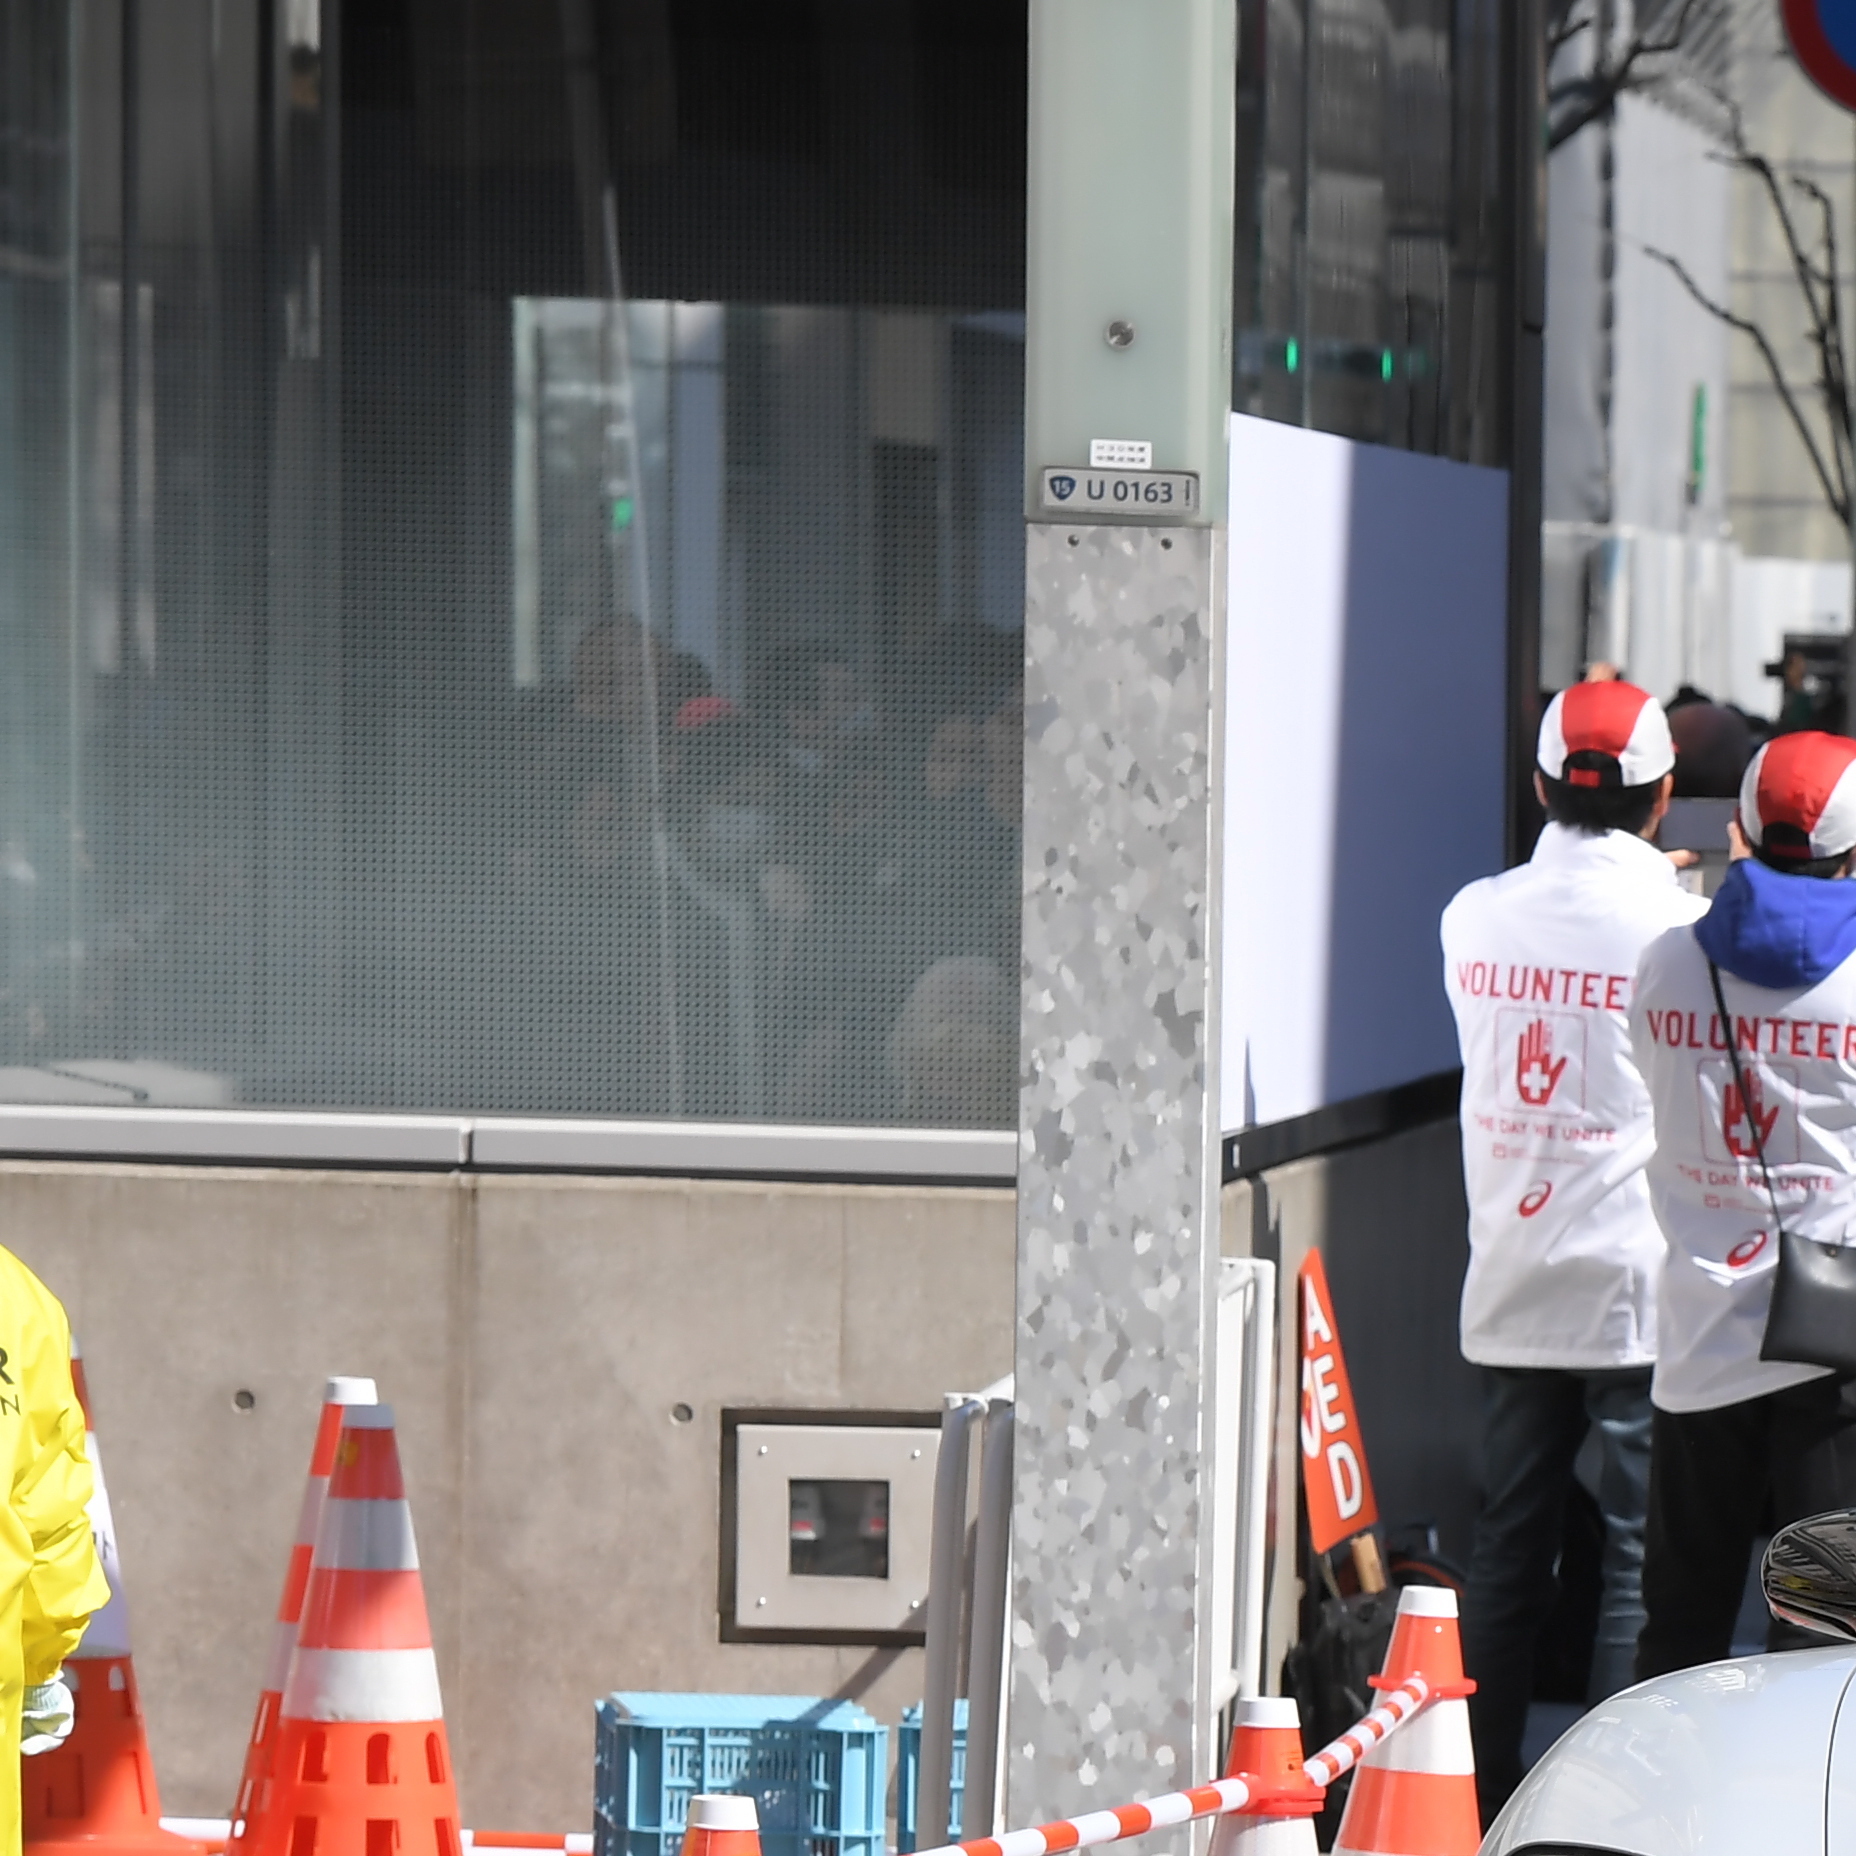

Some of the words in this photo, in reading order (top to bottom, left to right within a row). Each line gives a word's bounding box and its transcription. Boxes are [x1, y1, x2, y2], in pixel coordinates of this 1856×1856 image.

[1087, 480, 1104, 500] U
[1113, 480, 1173, 504] 0163
[1457, 962, 1637, 1010] VOLUNTEE
[1303, 1274, 1363, 1521] AED
